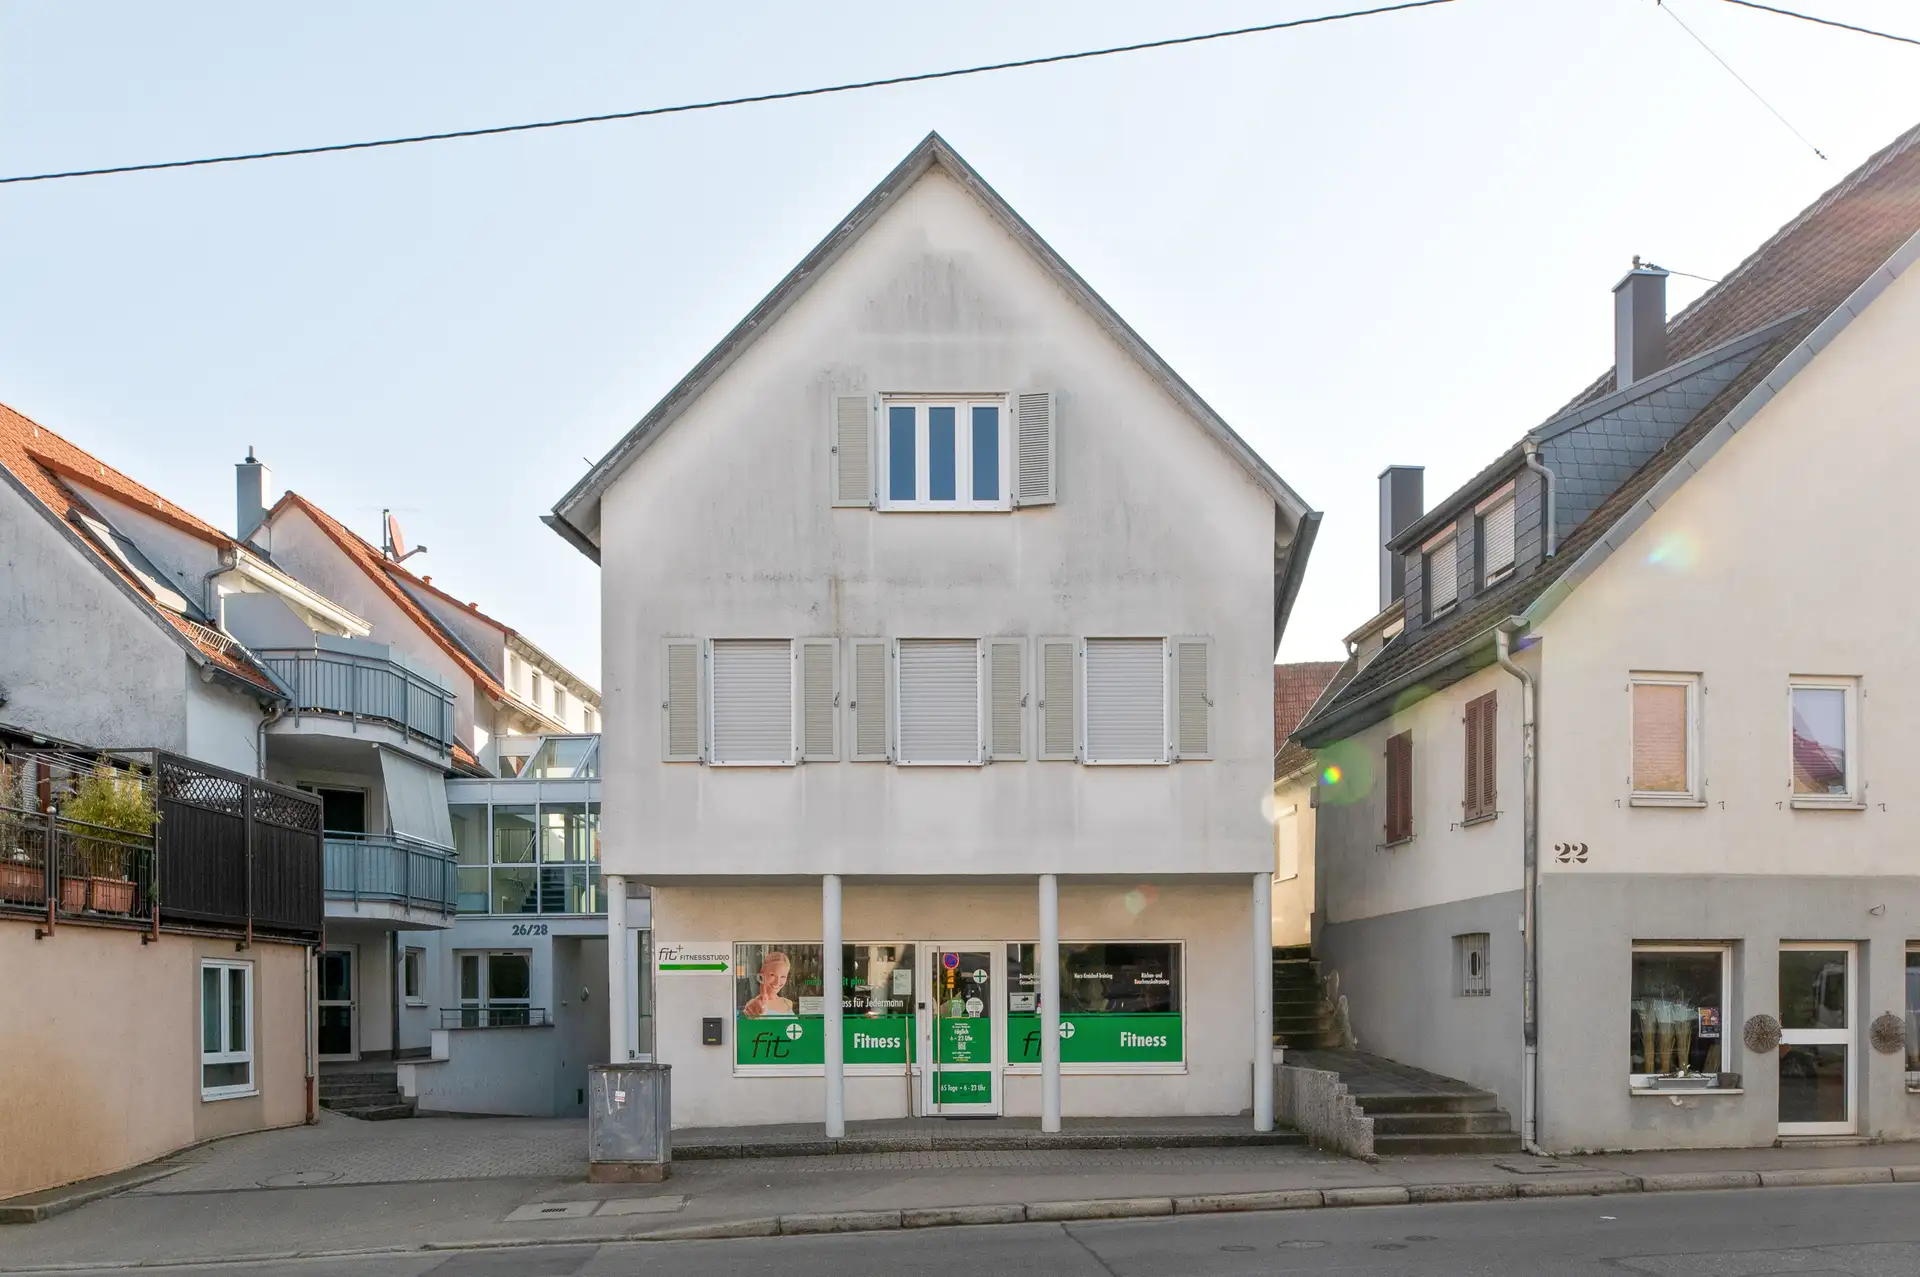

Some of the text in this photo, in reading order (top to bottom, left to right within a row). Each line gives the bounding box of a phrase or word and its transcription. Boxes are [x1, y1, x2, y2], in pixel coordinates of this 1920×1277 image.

[1554, 842, 1589, 864] 22
[512, 924, 548, 936] 26/28
[853, 997, 863, 1008] für
[865, 998, 904, 1008] Jedermann
[853, 1033, 901, 1049] Fitness
[1120, 1031, 1167, 1048] Fitness
